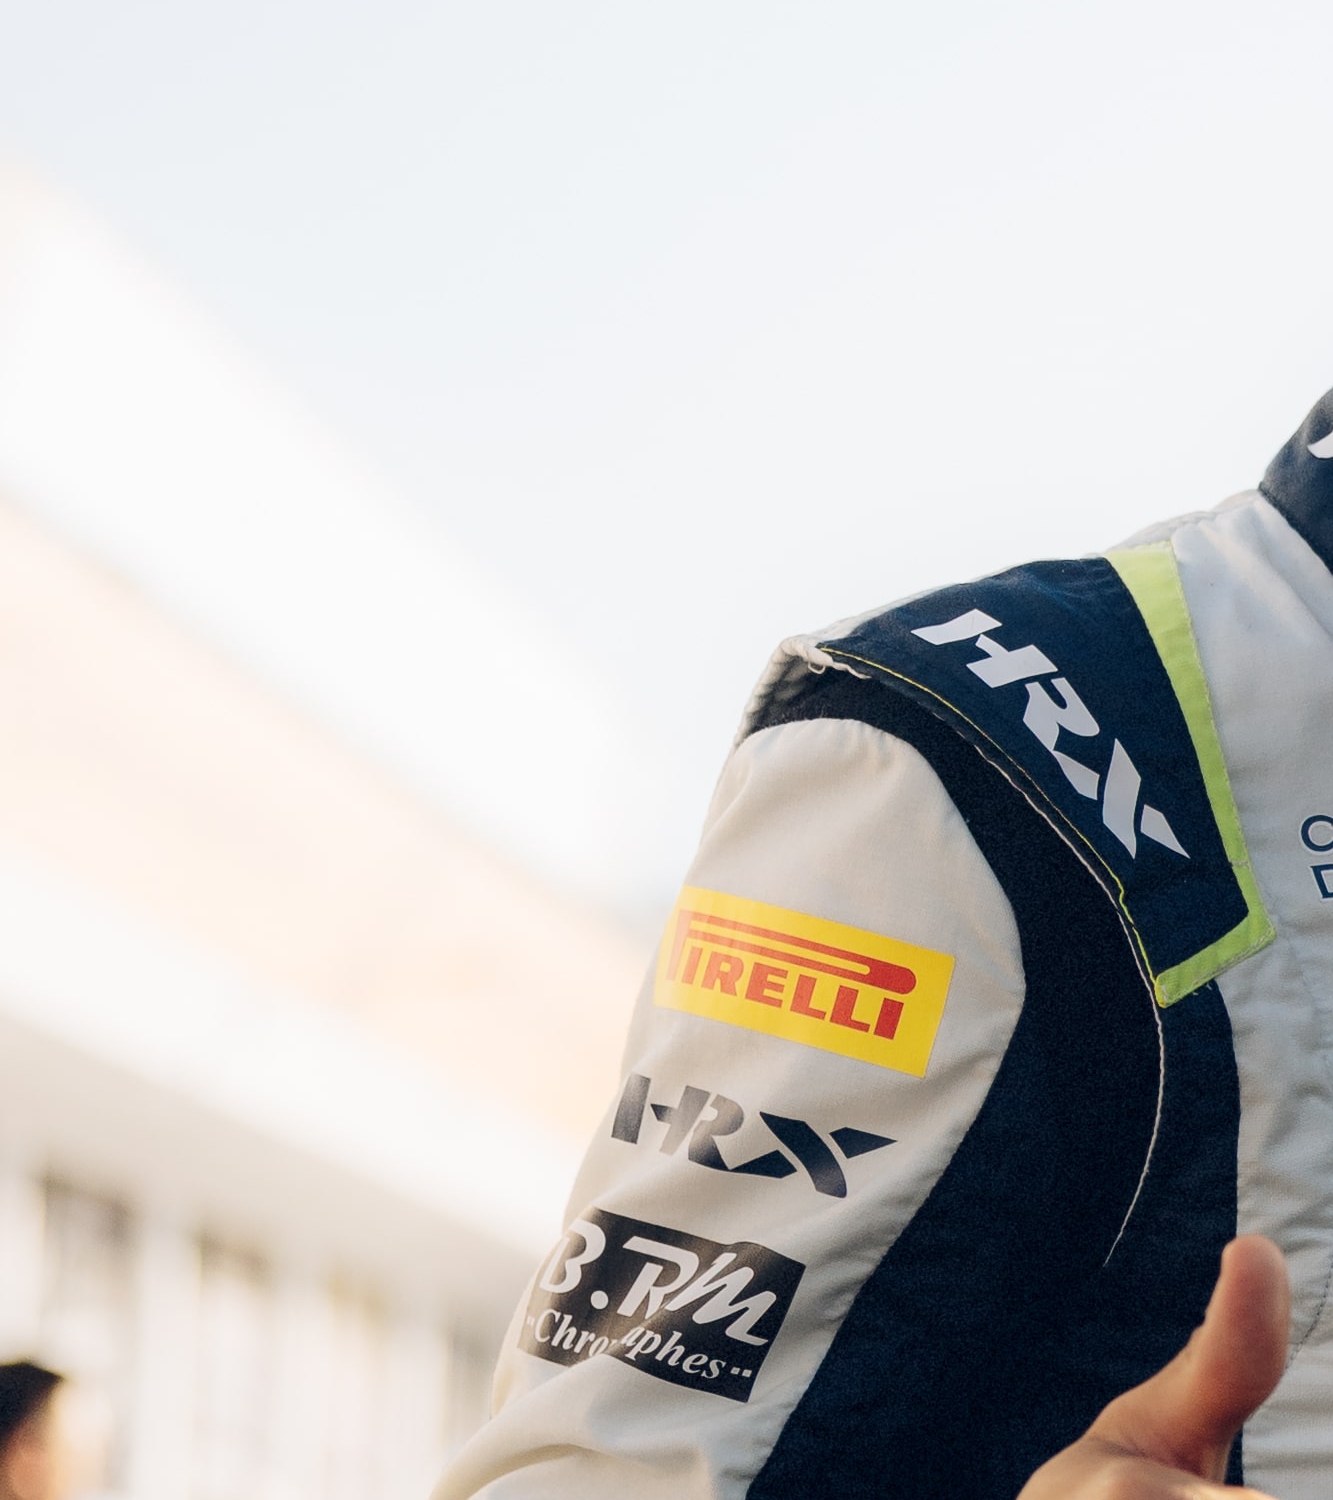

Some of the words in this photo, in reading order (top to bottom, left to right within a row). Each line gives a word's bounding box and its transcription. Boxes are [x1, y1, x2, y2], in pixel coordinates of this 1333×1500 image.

[910, 608, 1191, 860] HRX
[665, 909, 918, 1042] PIRELLI
[609, 1073, 899, 1200] HRX
